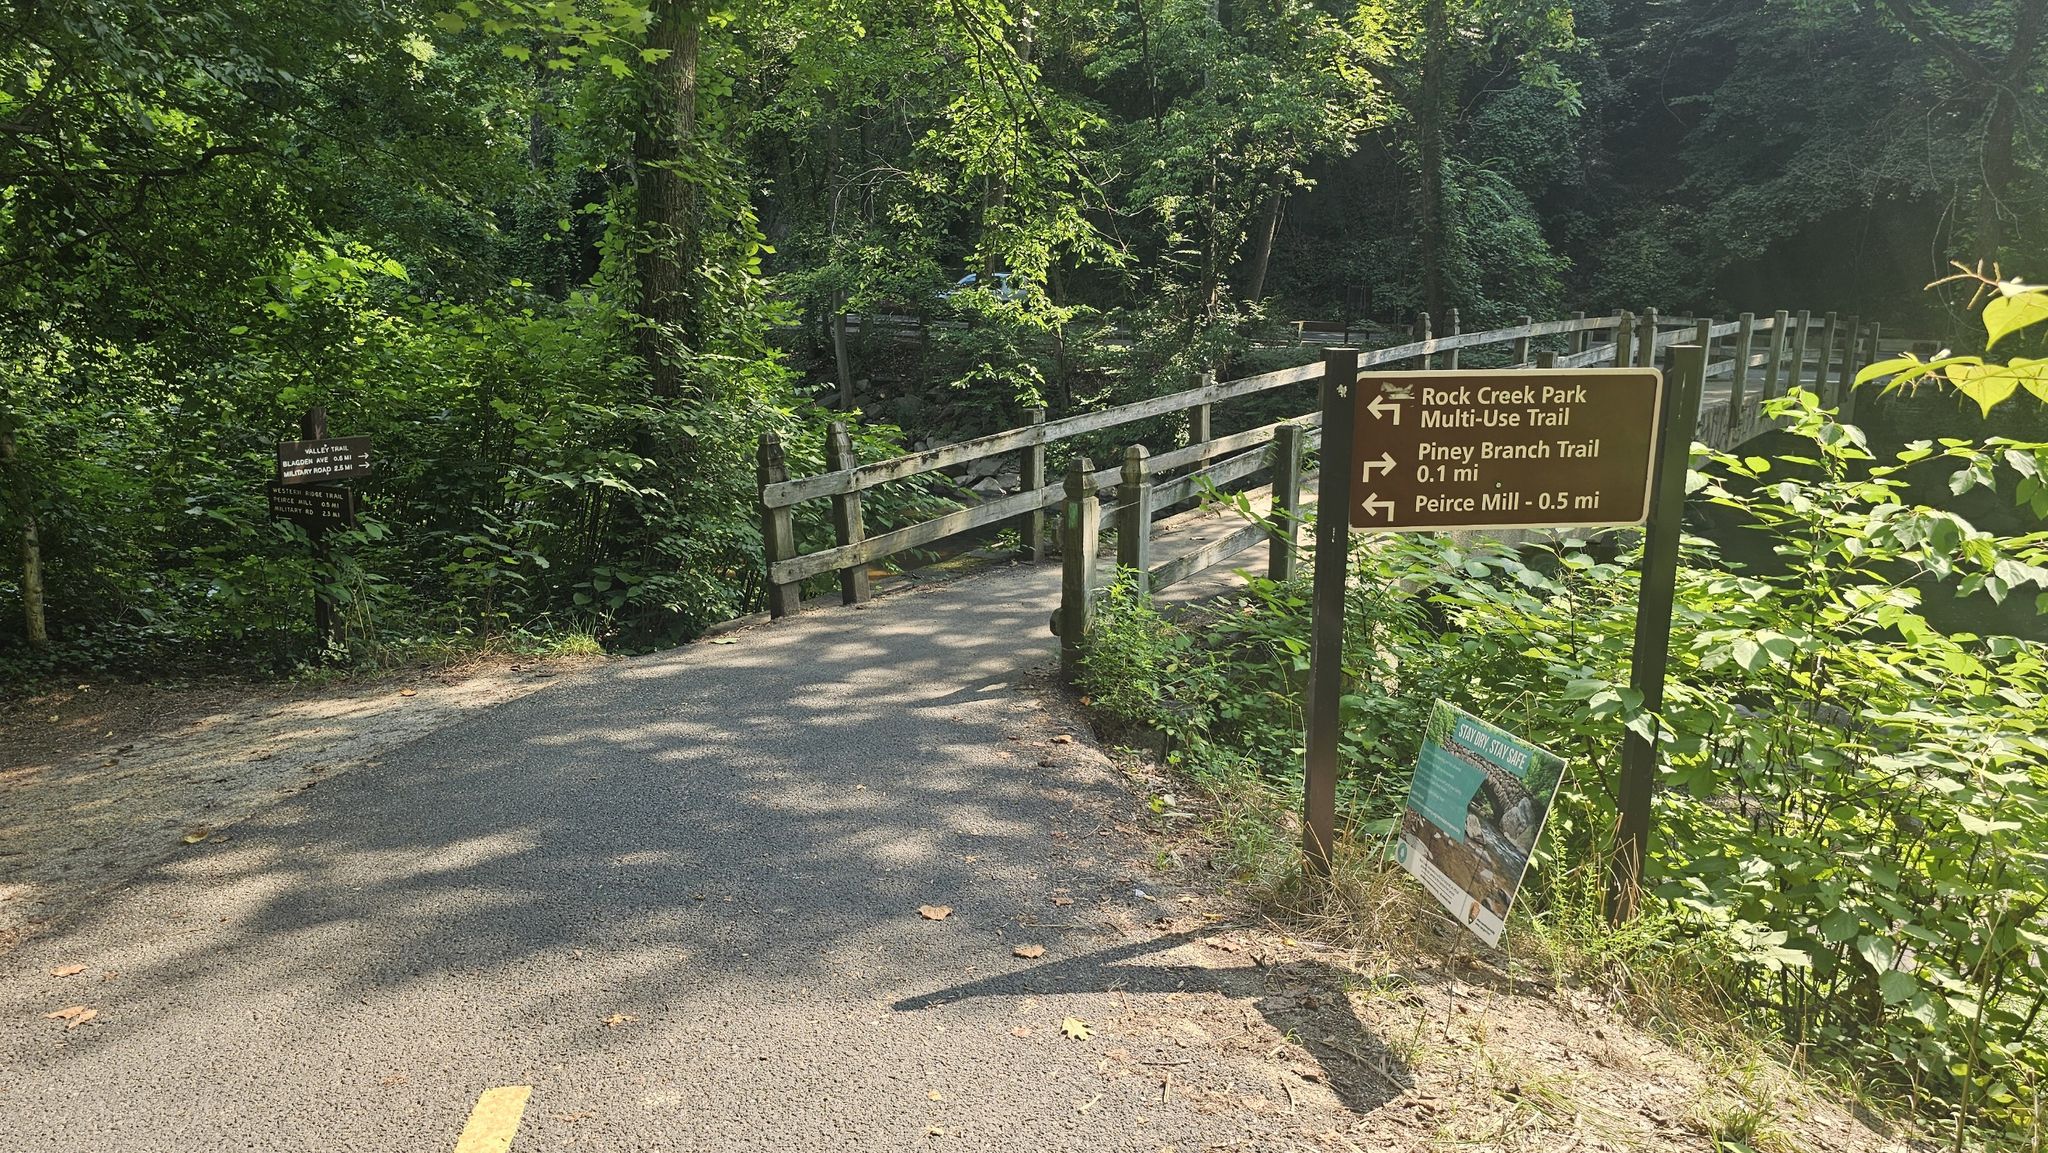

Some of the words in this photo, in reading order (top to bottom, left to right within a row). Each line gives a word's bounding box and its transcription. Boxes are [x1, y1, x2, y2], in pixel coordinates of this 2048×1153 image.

[1422, 386, 1470, 405] Rock
[1477, 385, 1535, 404] Creek
[1542, 385, 1587, 403] Park
[1420, 409, 1520, 428] Multi-Use
[1527, 408, 1569, 426] Trail
[1418, 442, 1474, 464] Piney
[1481, 440, 1550, 459] Branch
[1557, 439, 1599, 457] Trail
[283, 459, 313, 467] BLAGDEN
[283, 469, 312, 477] MILITARY
[1416, 465, 1447, 483] 0.1
[1453, 464, 1479, 482] mi
[1415, 494, 1475, 513] Peirce
[1481, 492, 1520, 511] Mill
[1538, 492, 1569, 510] 0.5
[1574, 491, 1600, 509] mi
[1458, 724, 1476, 743] STAY
[1475, 730, 1489, 753] DRY,
[1489, 739, 1509, 760] STAY
[1506, 748, 1528, 770] SAFE
